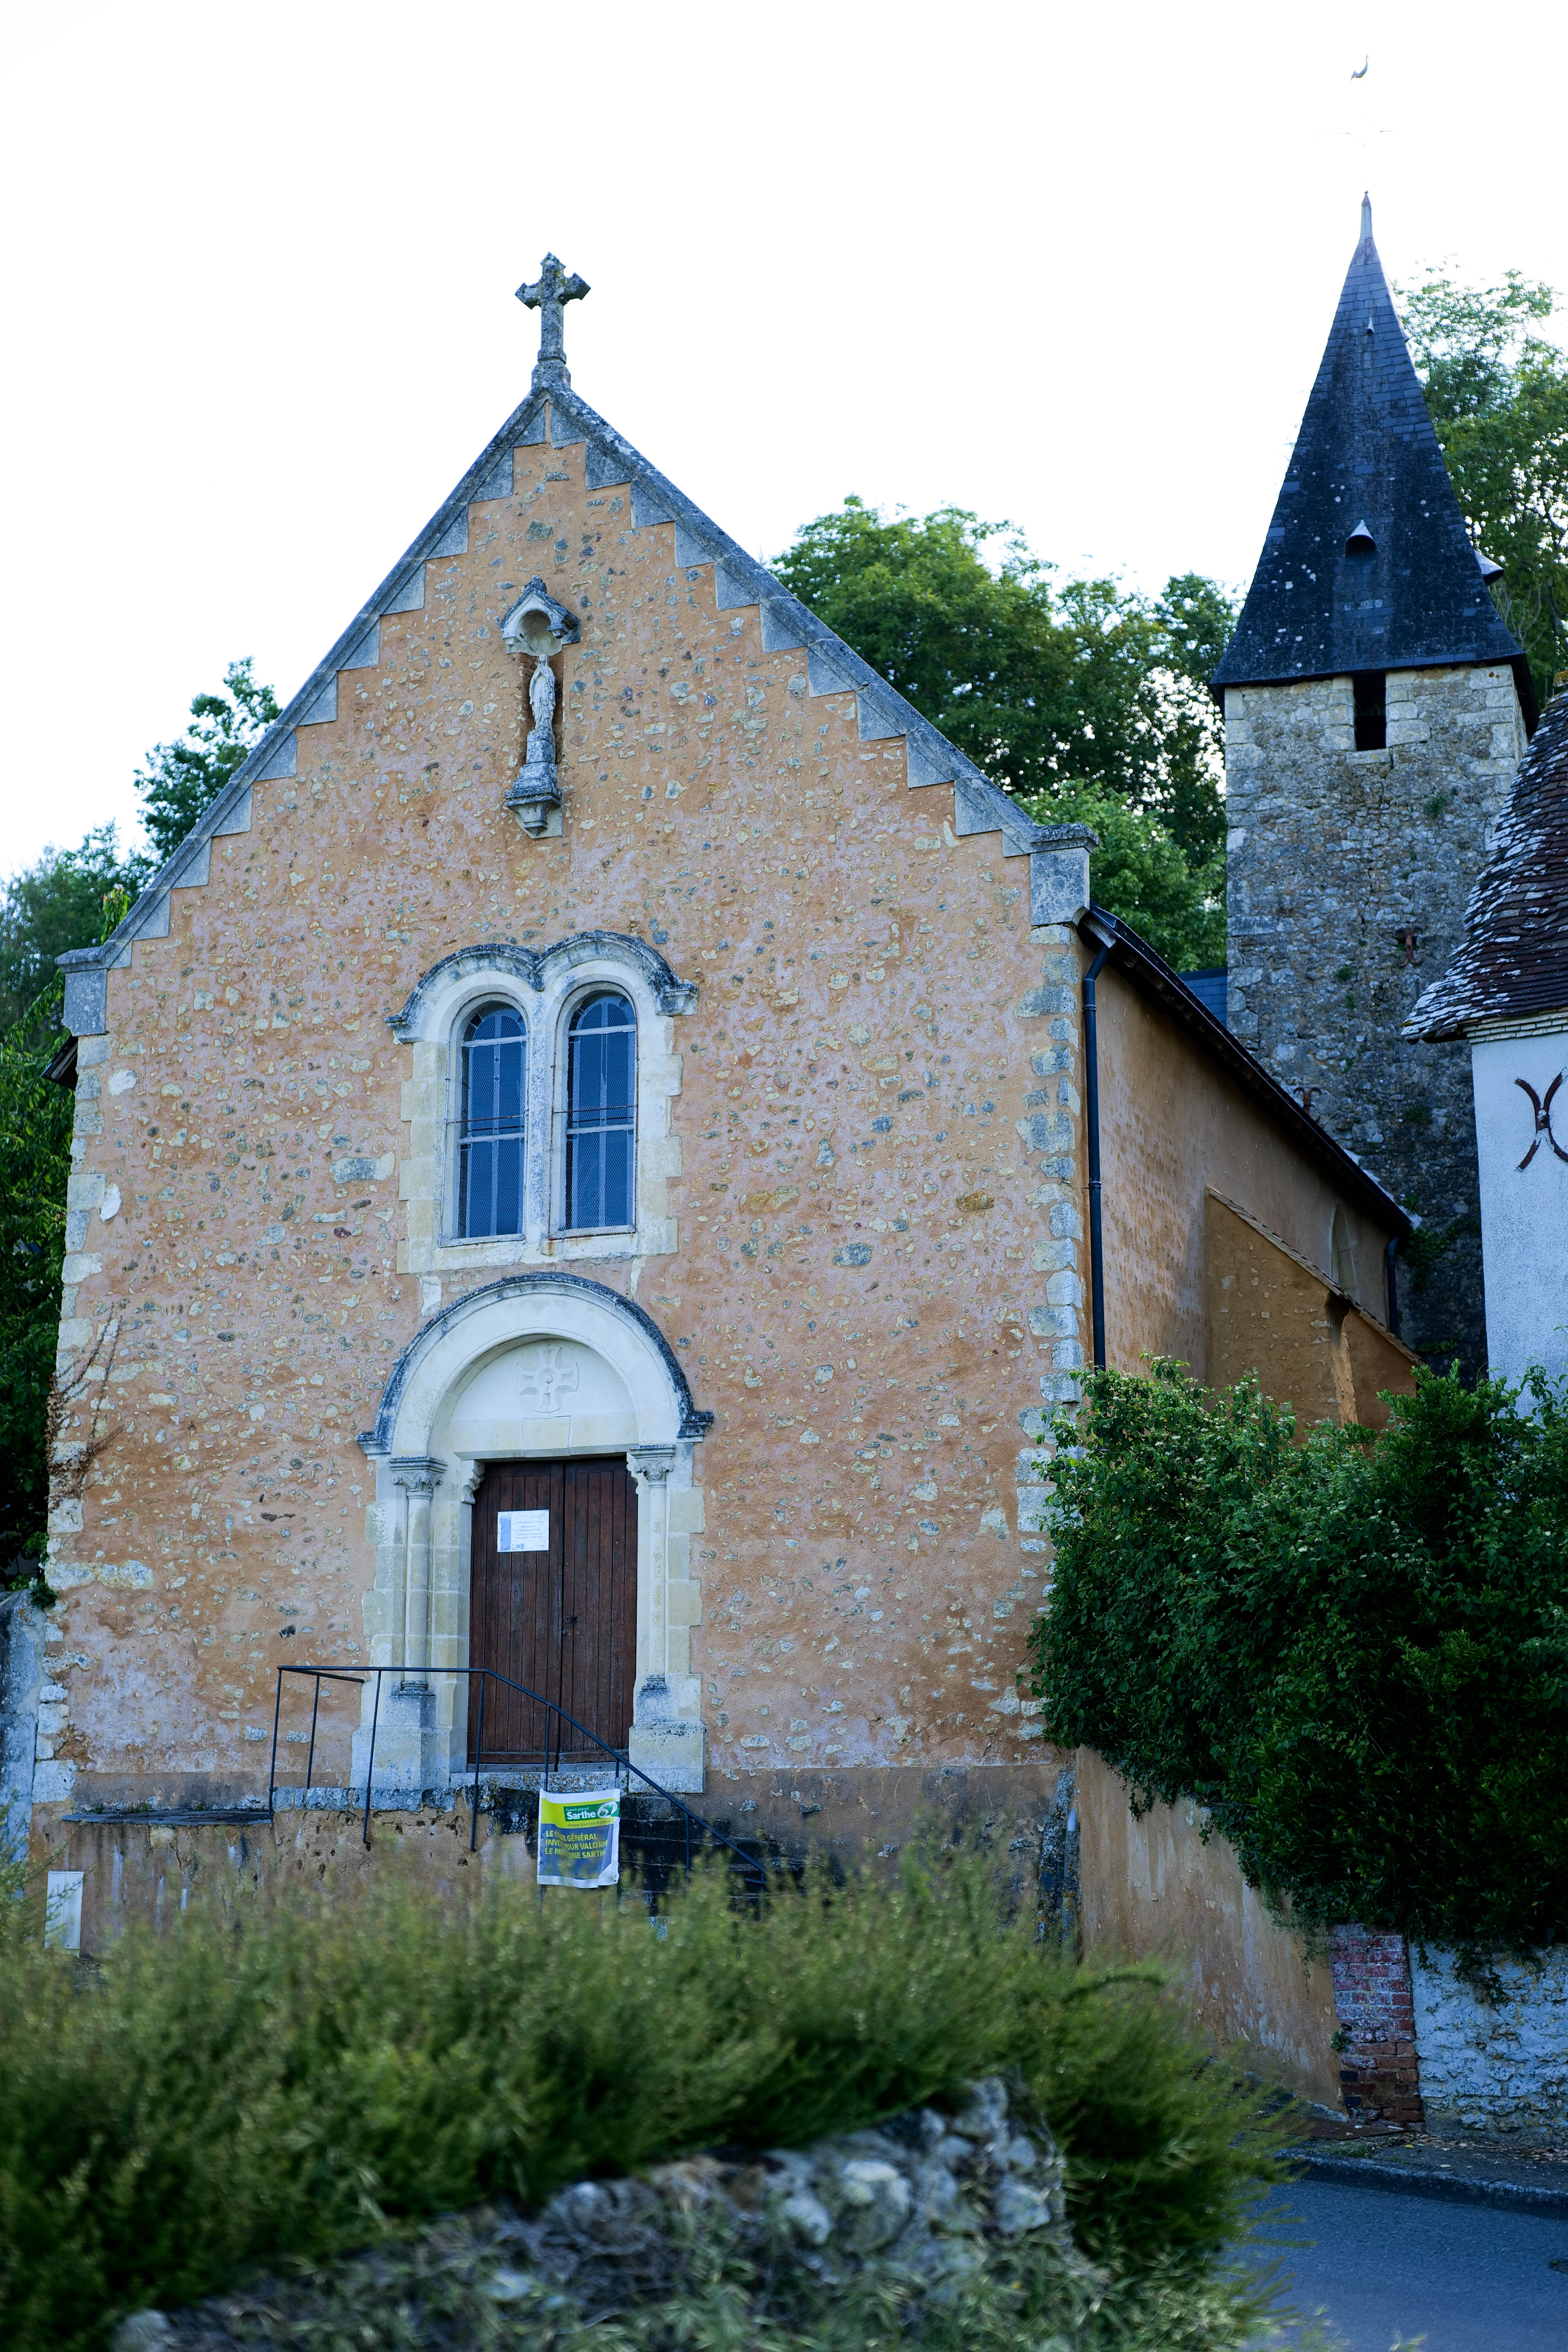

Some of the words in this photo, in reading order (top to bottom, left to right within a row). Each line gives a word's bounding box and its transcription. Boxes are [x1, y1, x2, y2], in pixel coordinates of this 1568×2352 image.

[567, 1810, 596, 1820] Sarthe
[555, 1831, 567, 1841] CEIL
[567, 1833, 598, 1842] GÉNÉRAL
